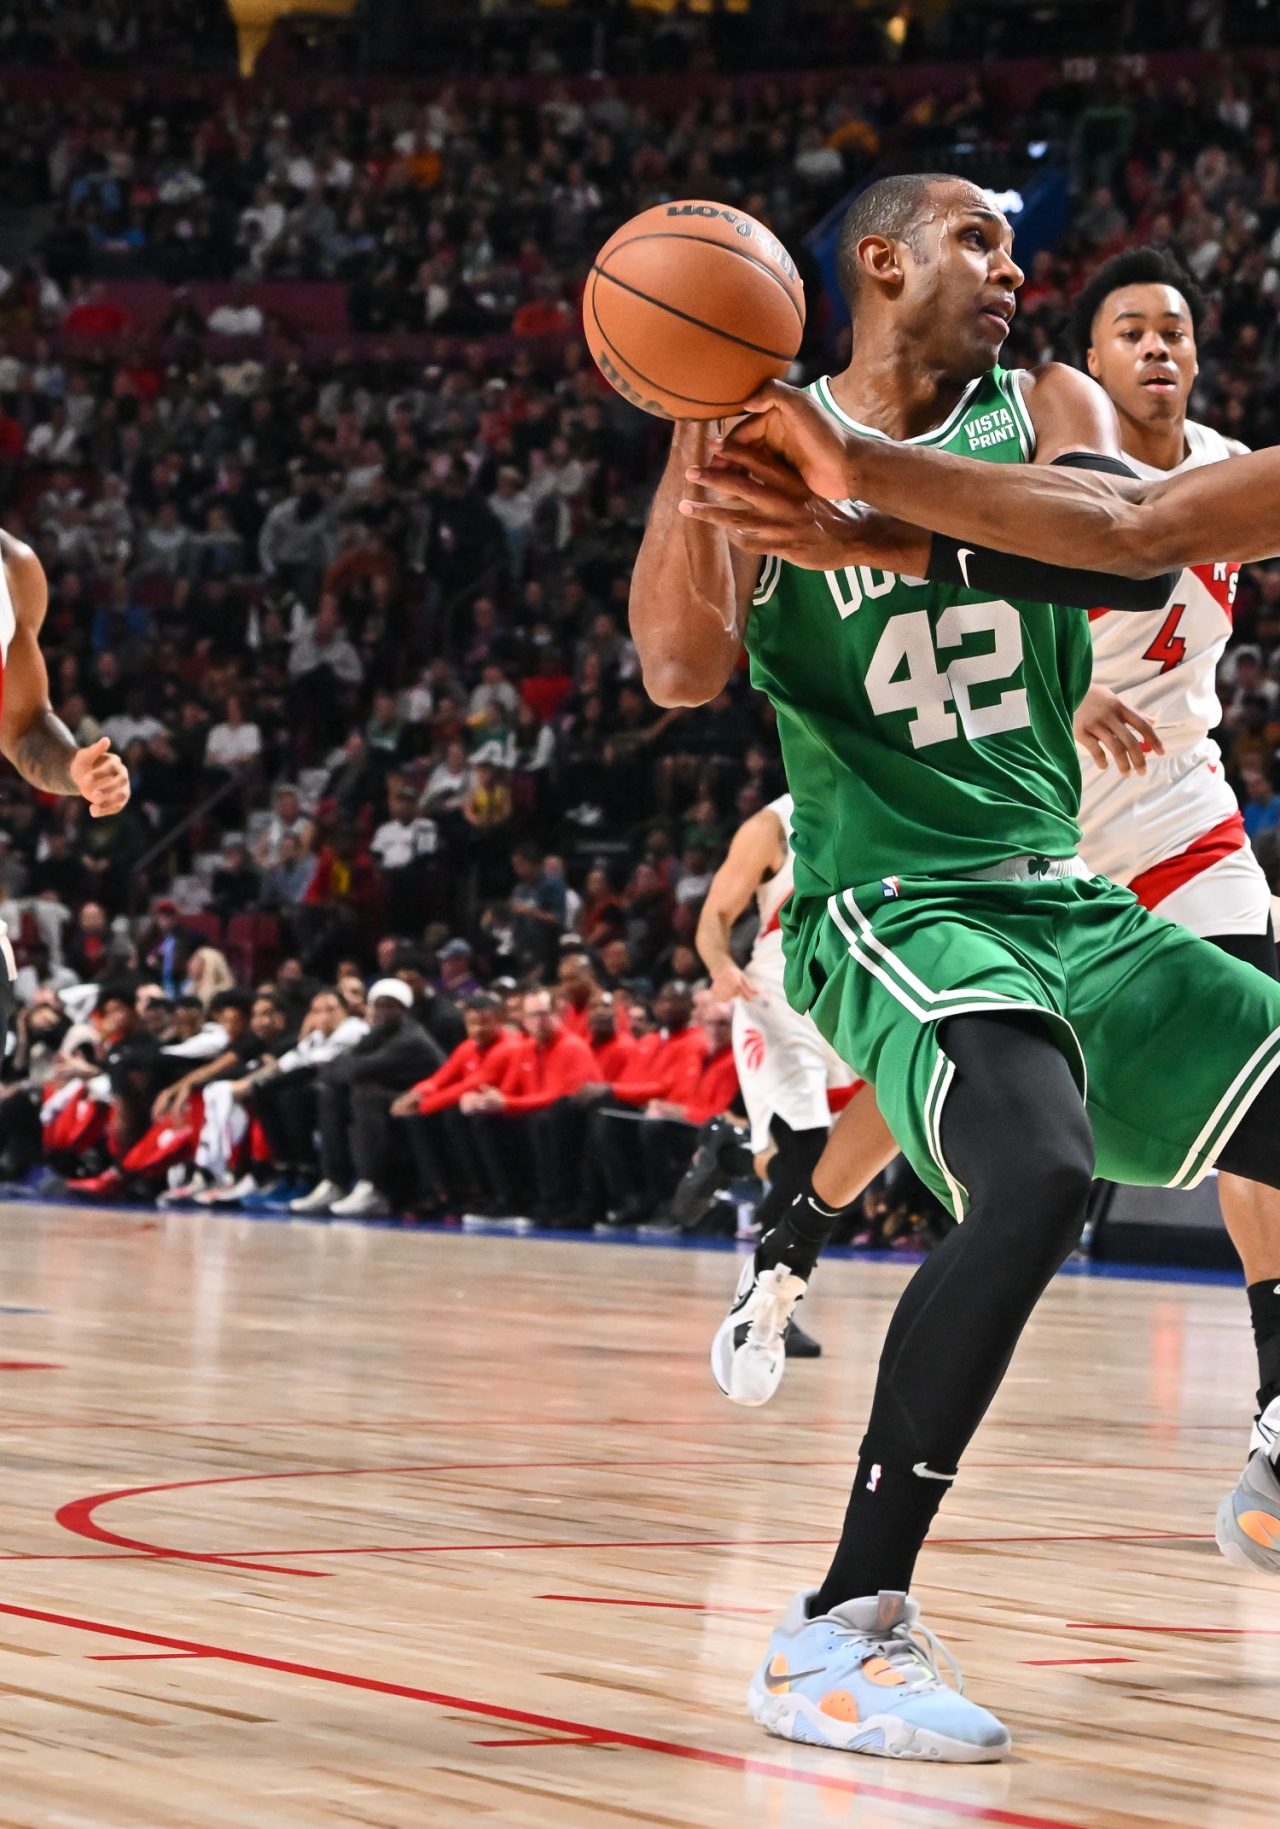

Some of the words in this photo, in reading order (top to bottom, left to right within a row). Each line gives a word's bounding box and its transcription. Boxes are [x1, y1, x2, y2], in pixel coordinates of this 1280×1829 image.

[963, 408, 1013, 438] VISTA
[969, 423, 1015, 451] PRINT
[1141, 603, 1187, 675] 4
[863, 599, 1032, 750] 42
